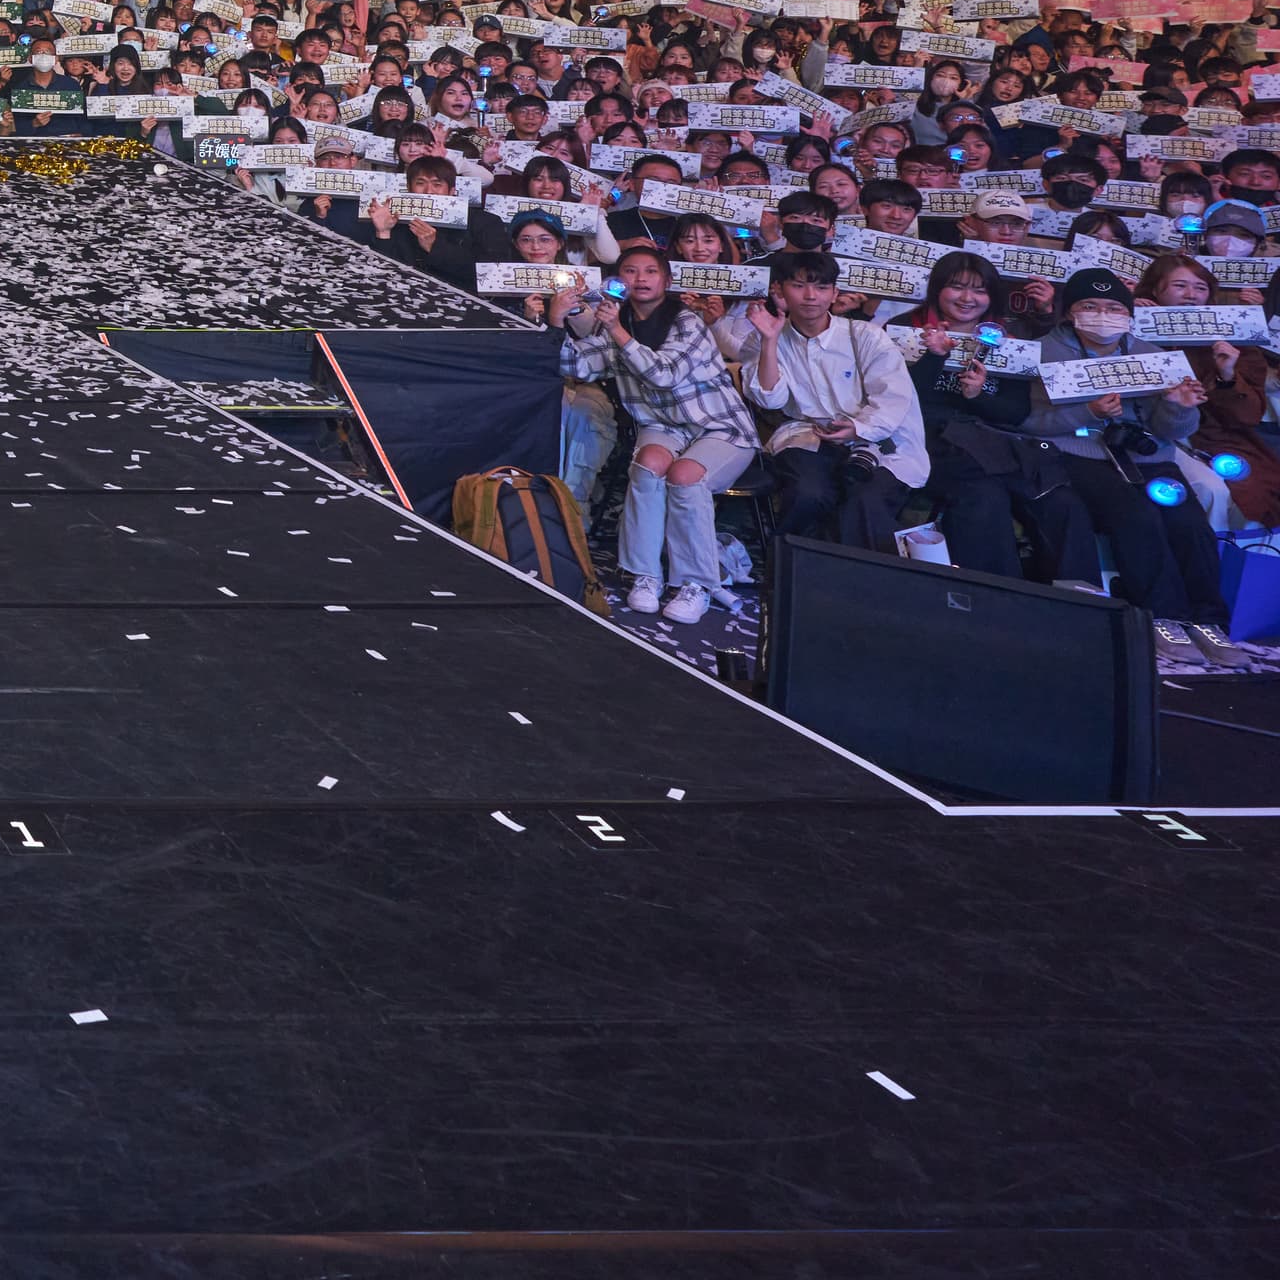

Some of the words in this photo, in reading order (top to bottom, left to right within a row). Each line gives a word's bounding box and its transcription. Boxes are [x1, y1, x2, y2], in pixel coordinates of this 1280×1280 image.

[10, 822, 44, 847] 1
[576, 815, 626, 841] 2
[1143, 814, 1207, 840] 3
